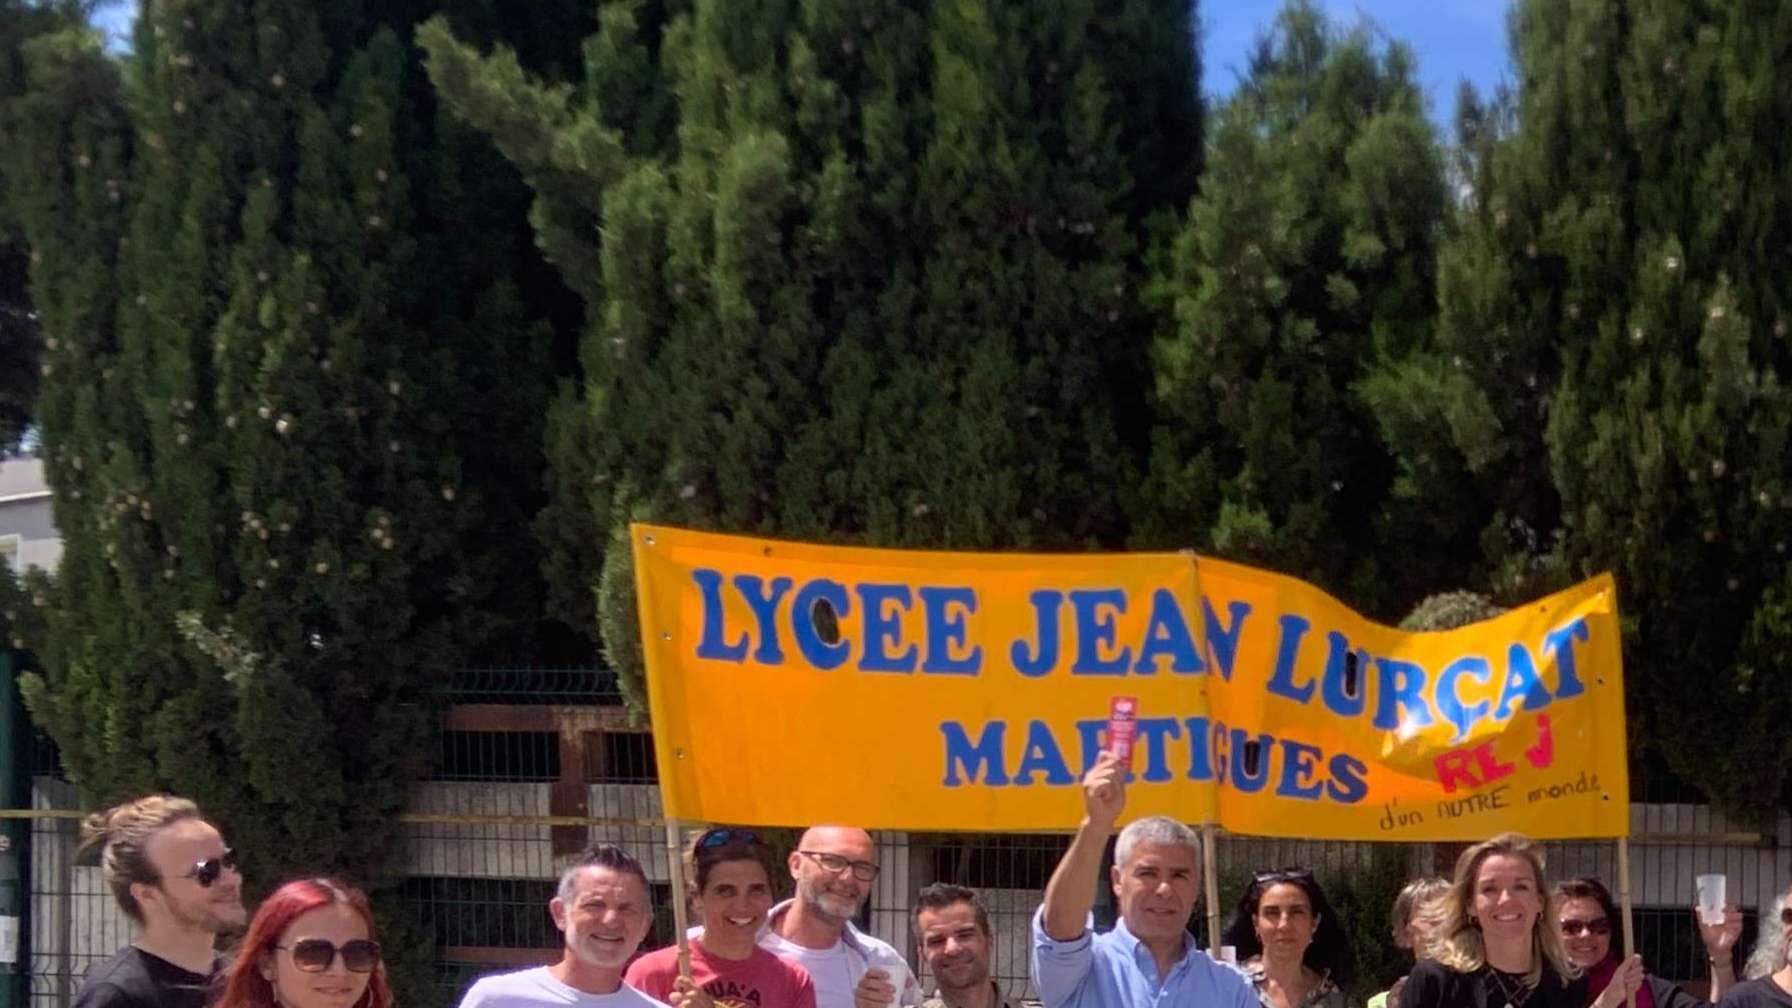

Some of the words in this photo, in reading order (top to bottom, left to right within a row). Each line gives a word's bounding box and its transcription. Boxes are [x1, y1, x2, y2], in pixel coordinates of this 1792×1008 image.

[691, 568, 983, 678] LYCEE
[1010, 587, 1252, 682] JEAN
[1267, 616, 1590, 746] LURÇAT
[1379, 797, 1424, 831] d'un
[1528, 771, 1601, 804] monde
